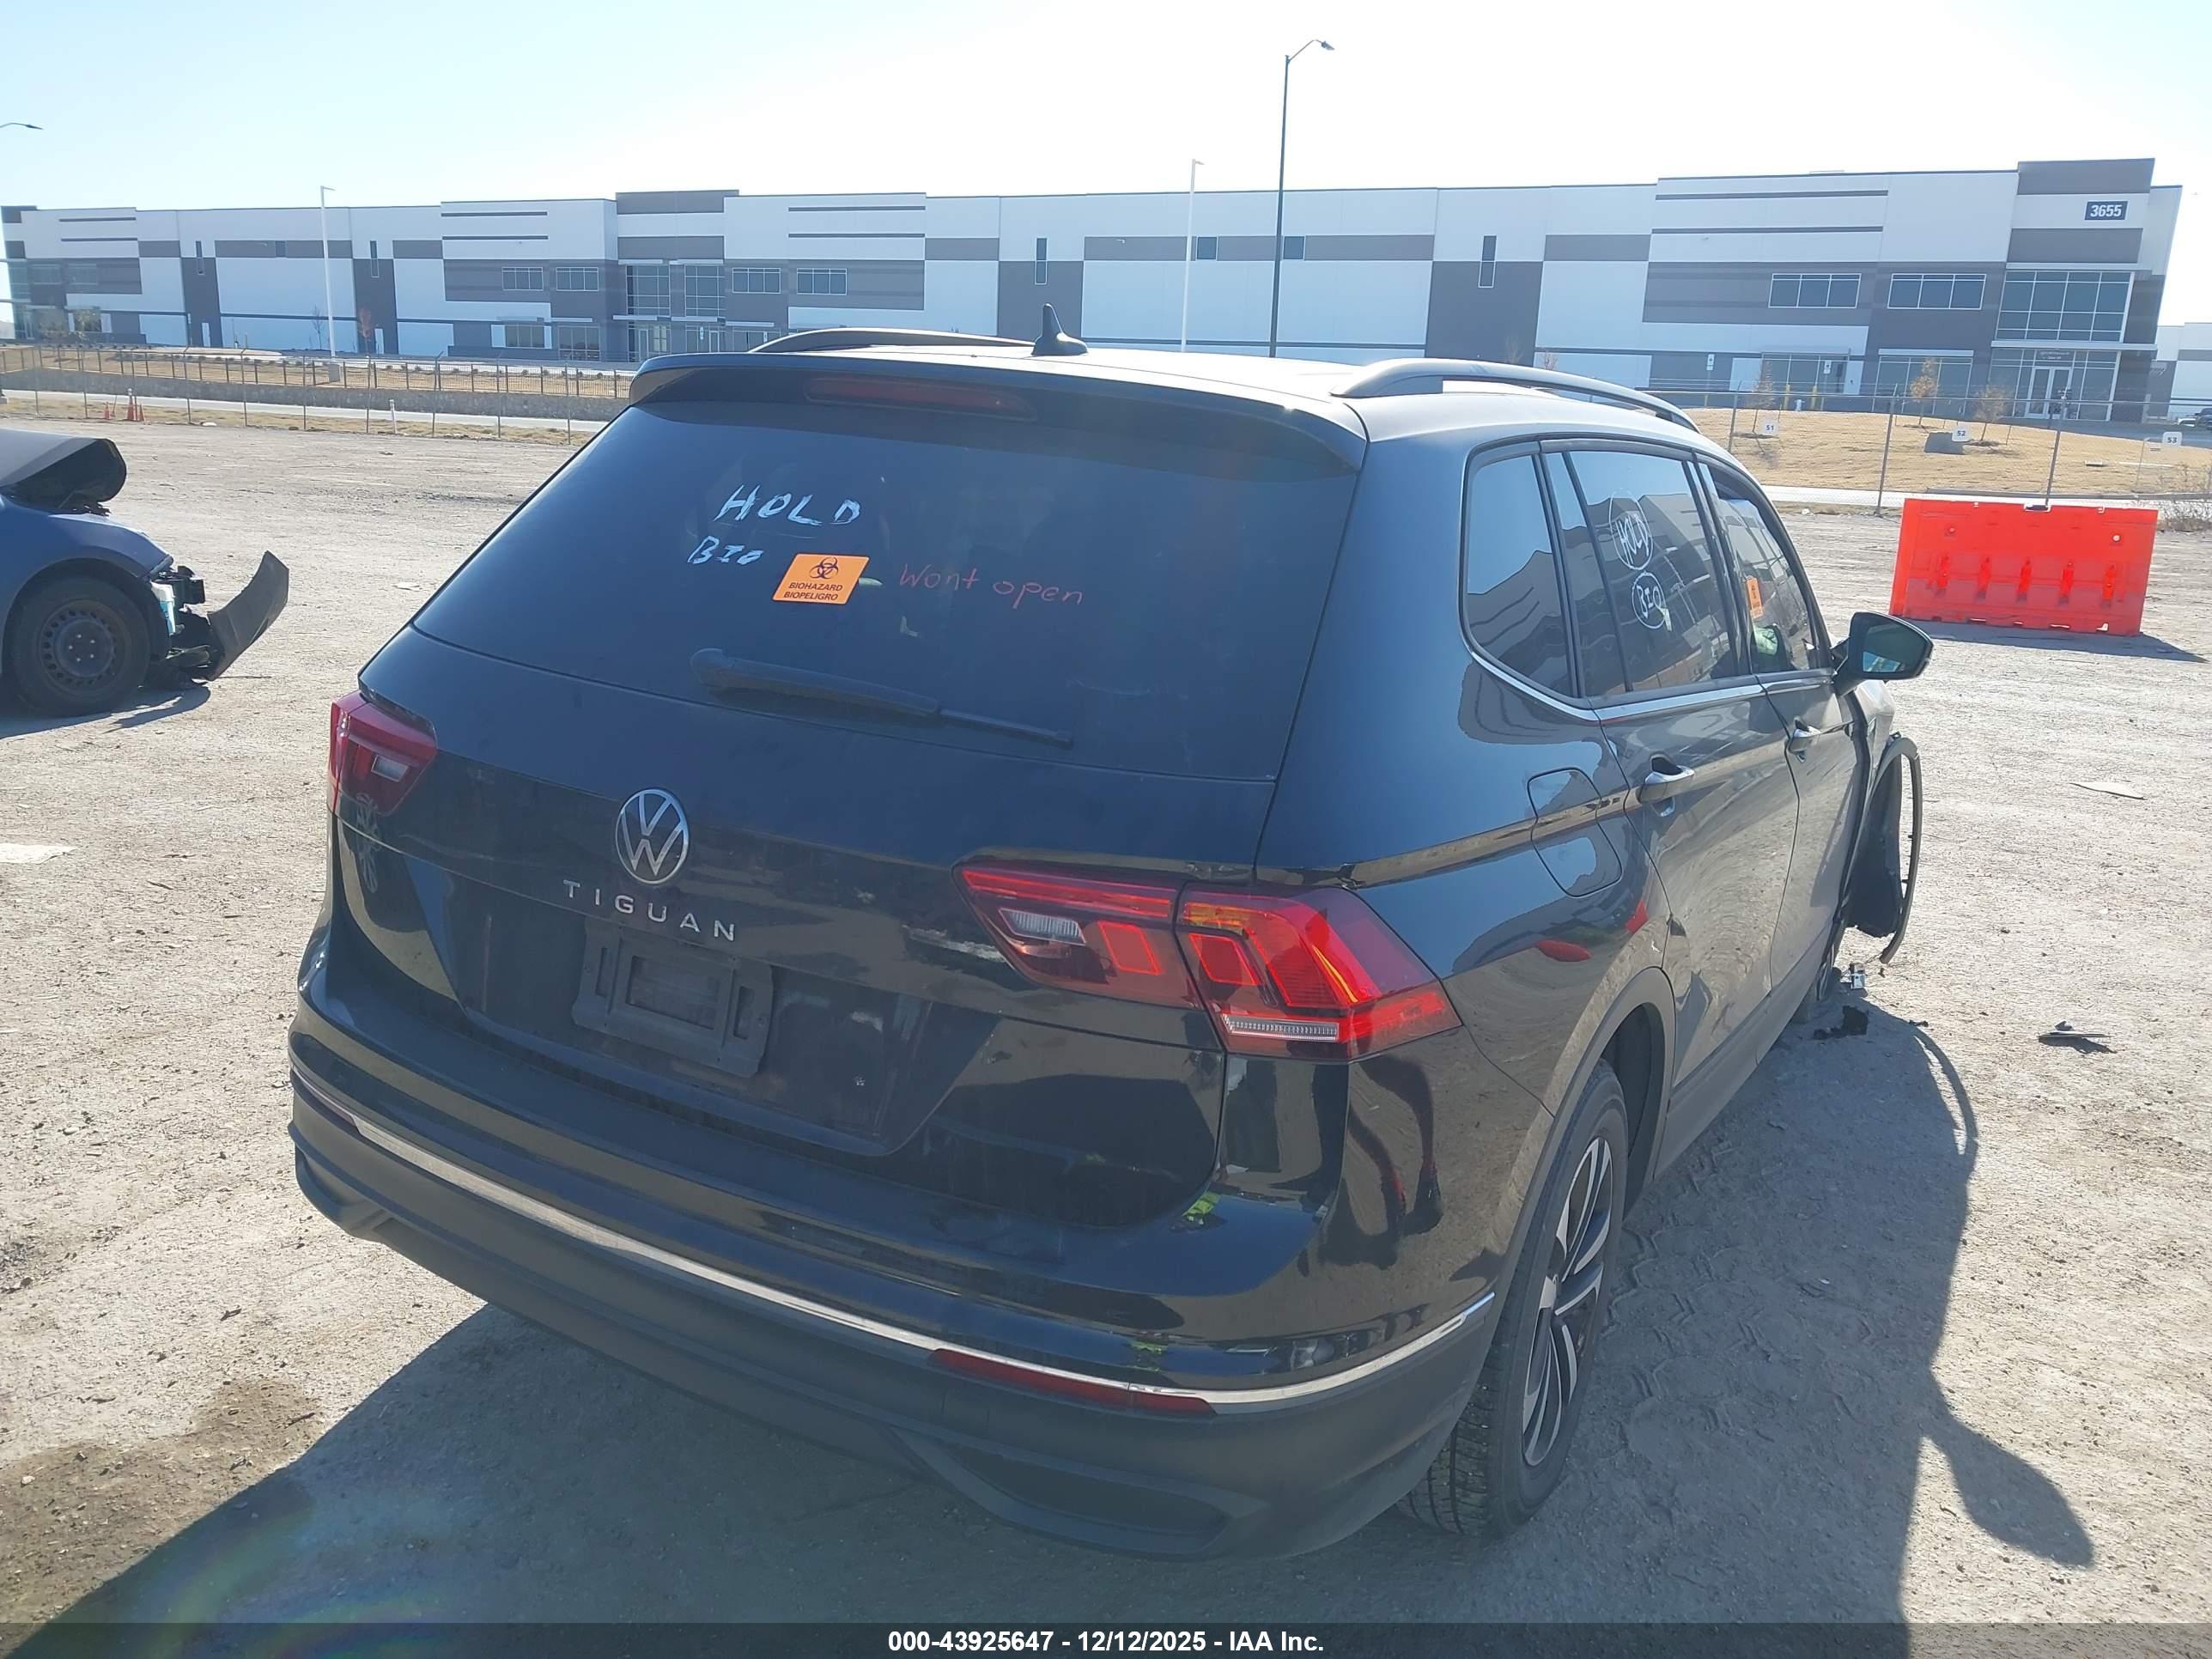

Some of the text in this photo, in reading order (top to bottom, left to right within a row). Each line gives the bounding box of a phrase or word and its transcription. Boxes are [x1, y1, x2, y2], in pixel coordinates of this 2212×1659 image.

[2090, 204, 2122, 216] 3655
[714, 485, 861, 526] HOLD
[687, 536, 764, 565] BIO
[1615, 513, 1649, 565] HOLD
[783, 592, 839, 601] BIOPELIGRO
[788, 582, 843, 592] BIOHAZARD
[900, 563, 1084, 609] Wont open
[1636, 585, 1662, 619] BIO
[562, 879, 736, 941] TIGUAN
